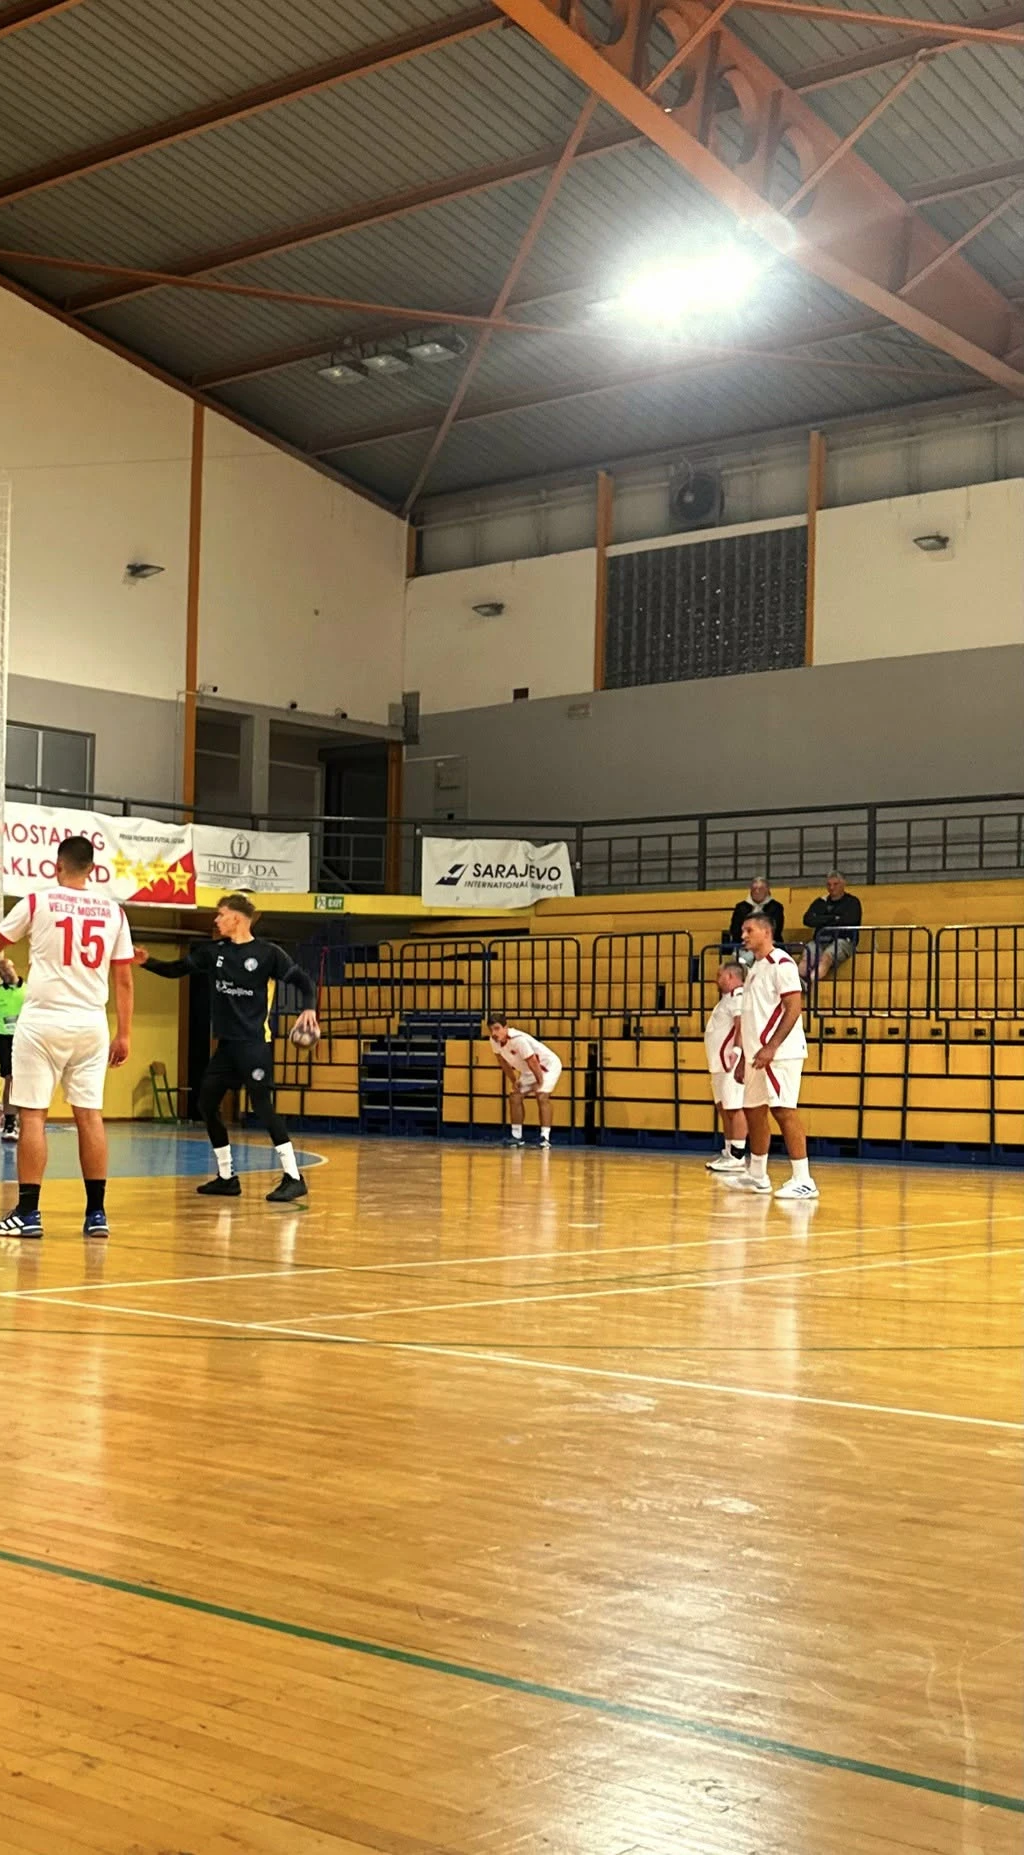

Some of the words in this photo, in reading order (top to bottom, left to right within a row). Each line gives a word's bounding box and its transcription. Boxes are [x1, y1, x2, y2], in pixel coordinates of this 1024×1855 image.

[207, 860, 243, 876] HOTEL
[472, 863, 562, 882] SARAJEVO
[463, 880, 529, 890] INTERNATIONAL
[55, 916, 106, 969] 15
